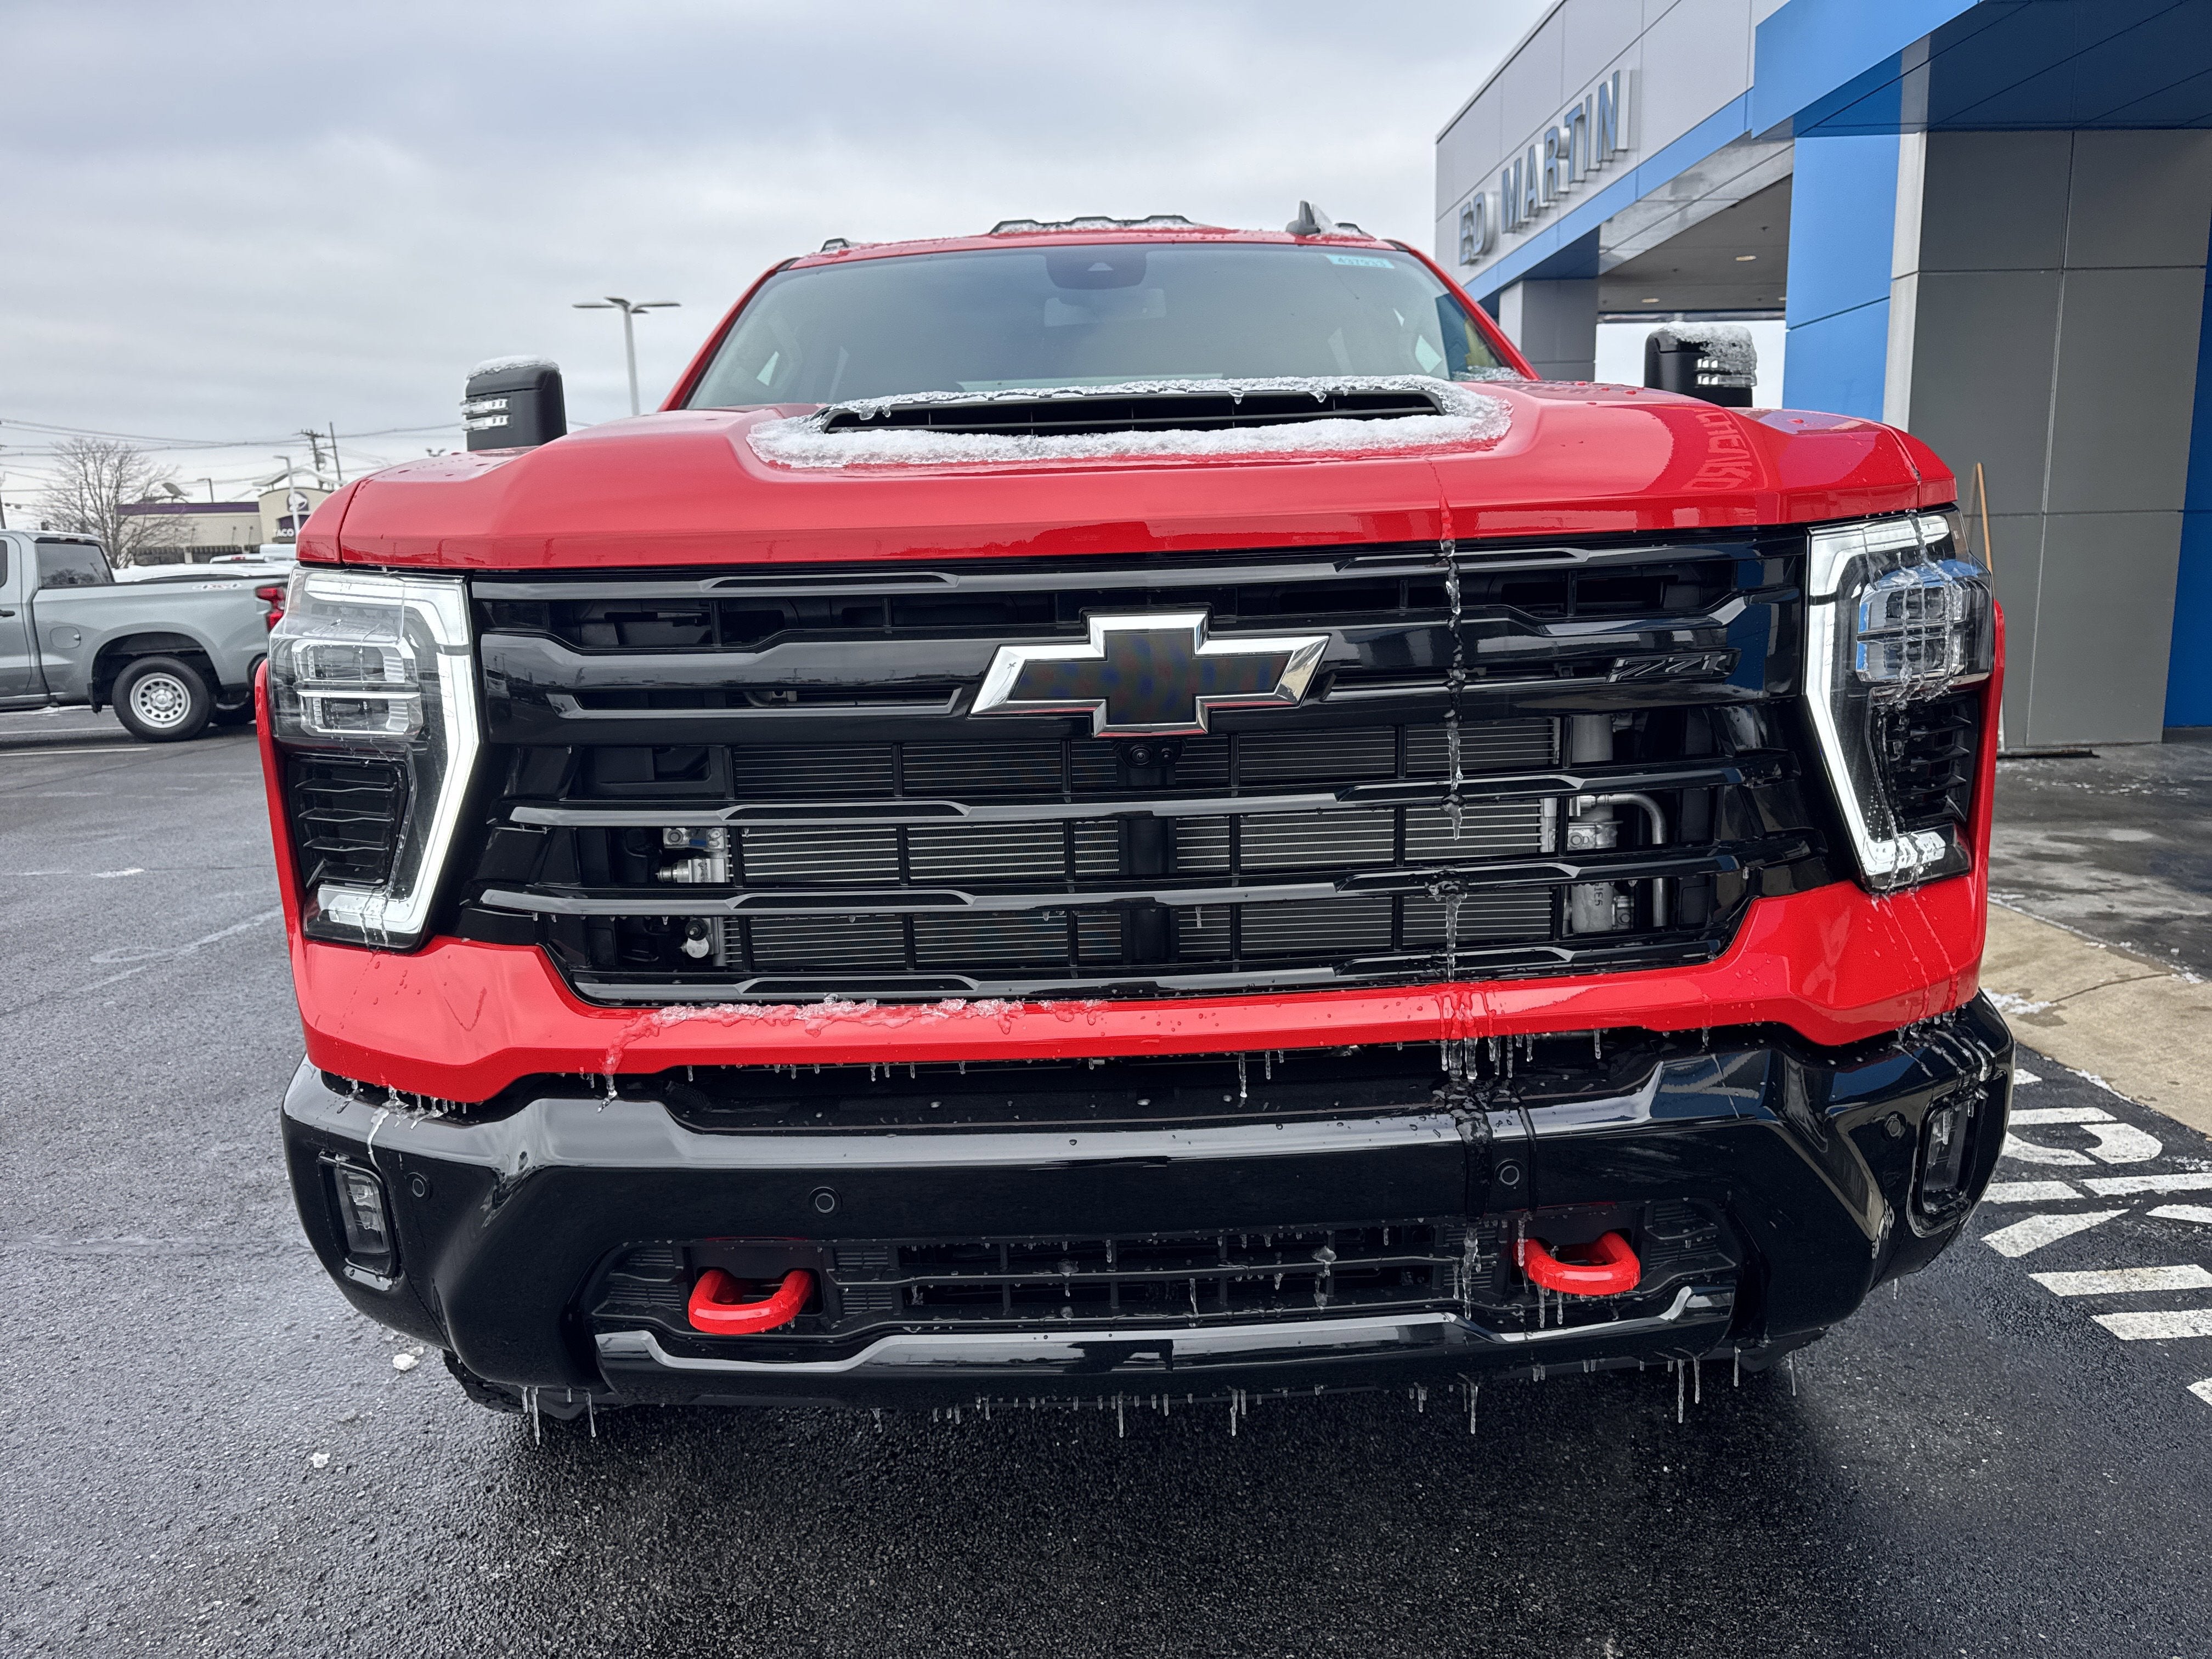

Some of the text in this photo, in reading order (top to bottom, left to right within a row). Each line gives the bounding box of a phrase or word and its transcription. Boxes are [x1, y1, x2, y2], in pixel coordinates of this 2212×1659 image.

[1459, 70, 1629, 266] ED MARTIN
[1606, 652, 1723, 682] Z71
